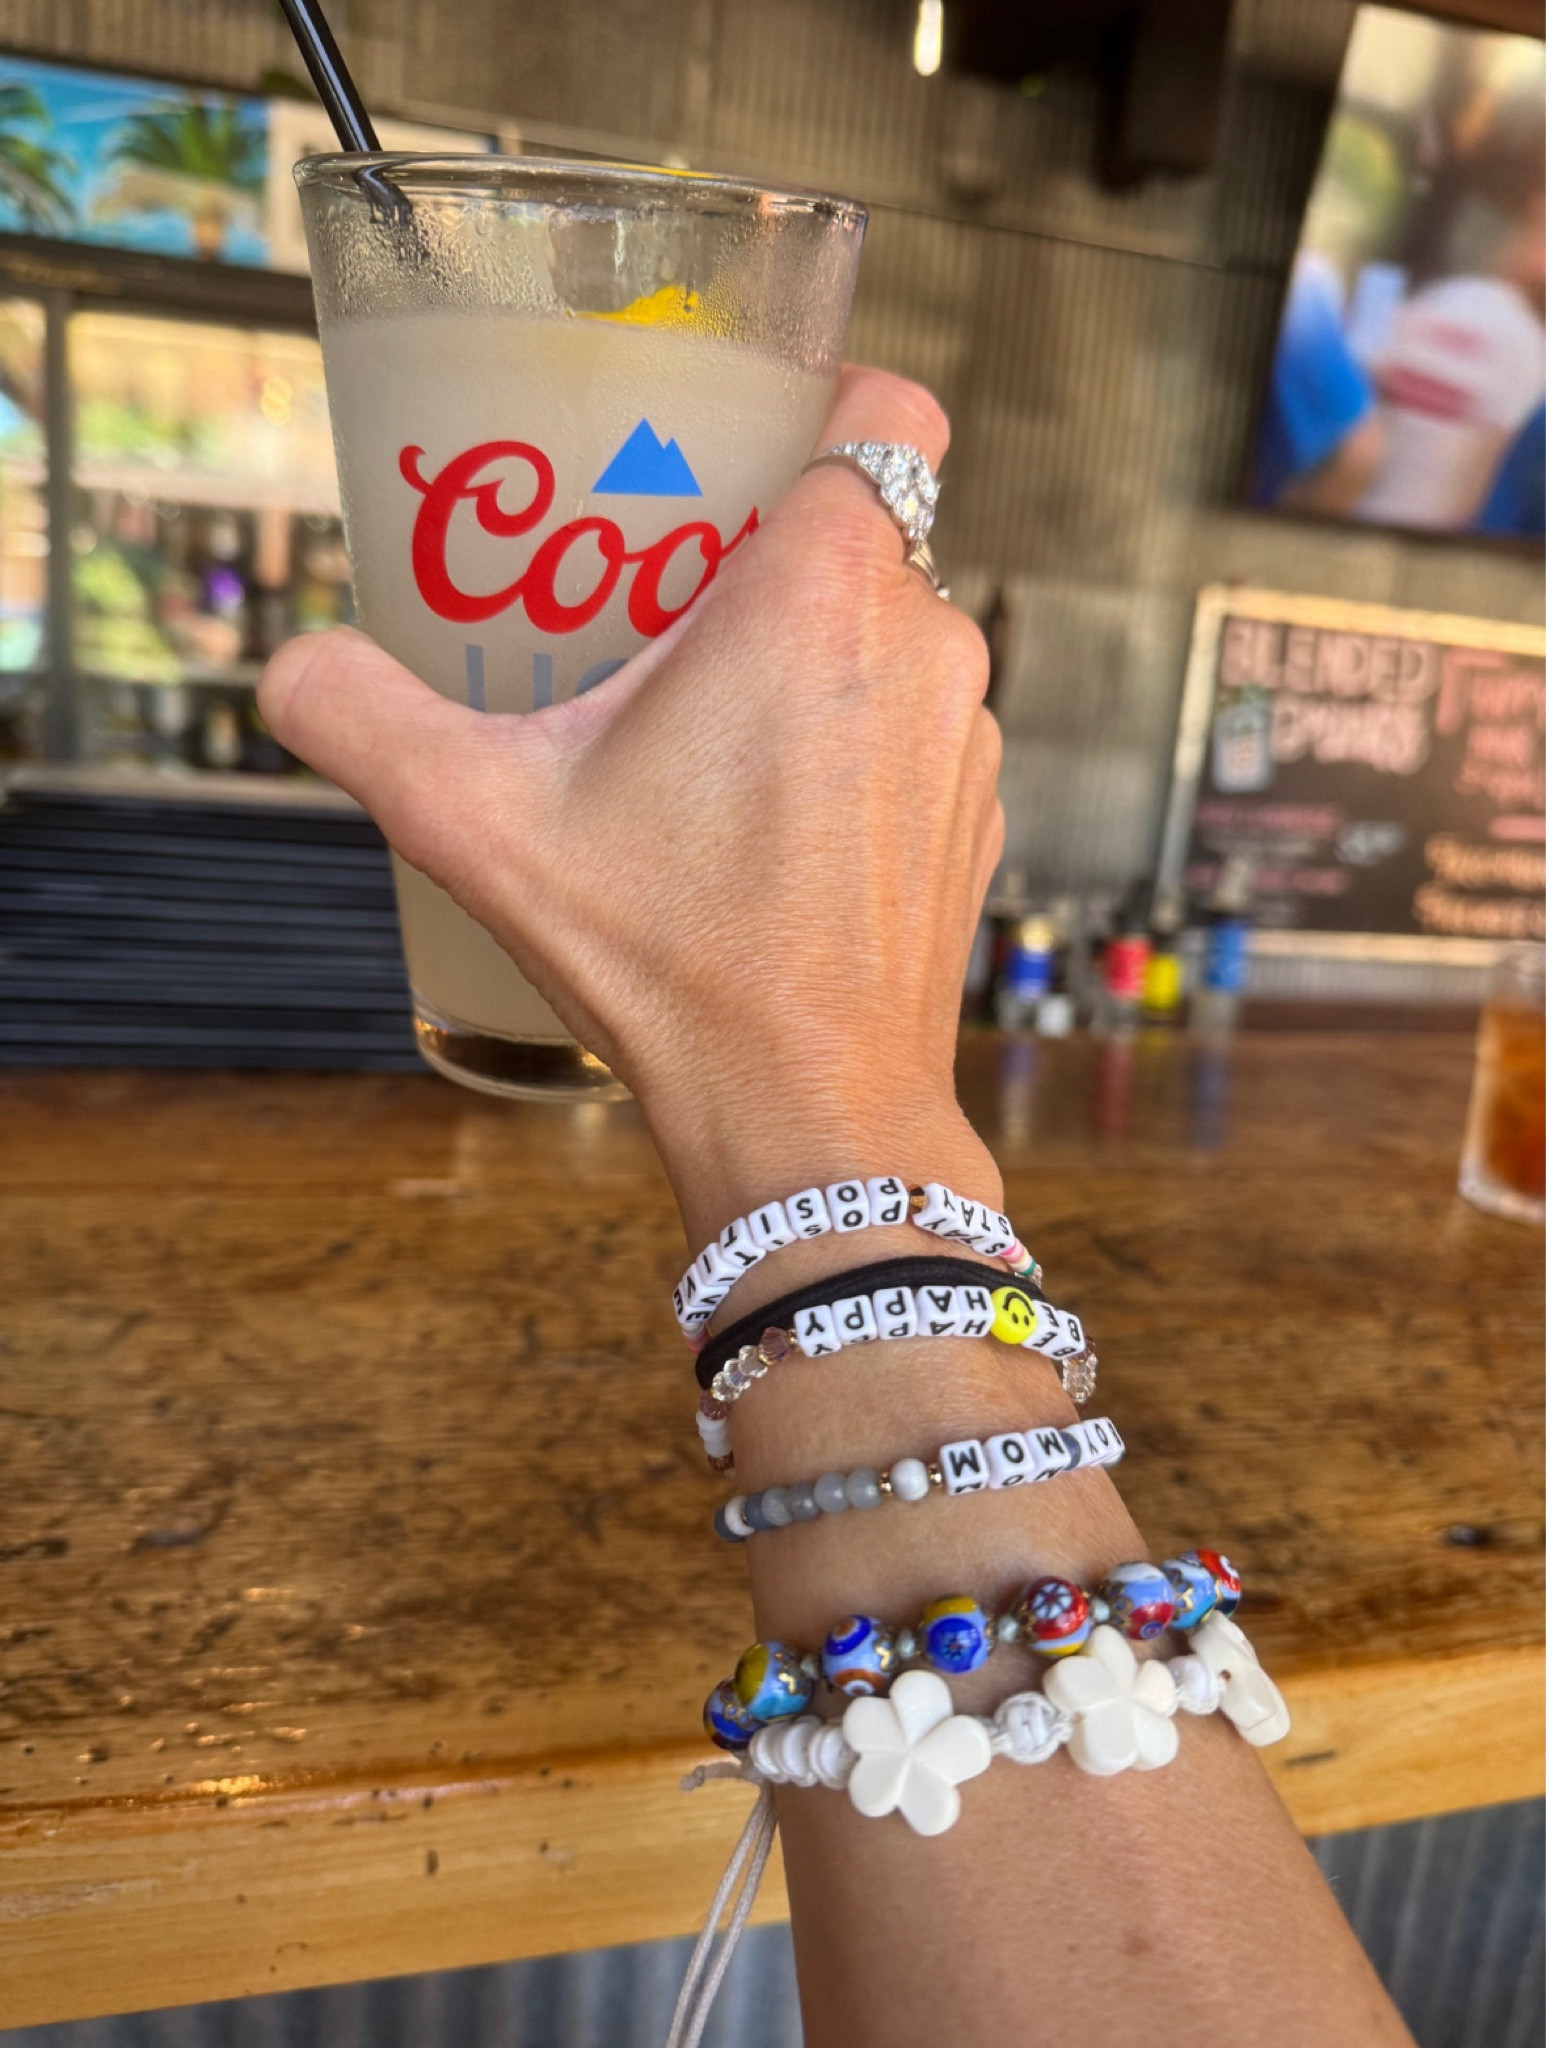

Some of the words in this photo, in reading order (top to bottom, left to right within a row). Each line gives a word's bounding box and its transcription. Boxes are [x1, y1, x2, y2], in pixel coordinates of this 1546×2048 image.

[399, 440, 759, 638] Coo
[673, 1177, 901, 1324] POSITIVE
[911, 1187, 1010, 1255] STAY
[805, 1289, 988, 1354] HAPPY
[1033, 1303, 1082, 1357] BE
[949, 1431, 1066, 1493] MOM
